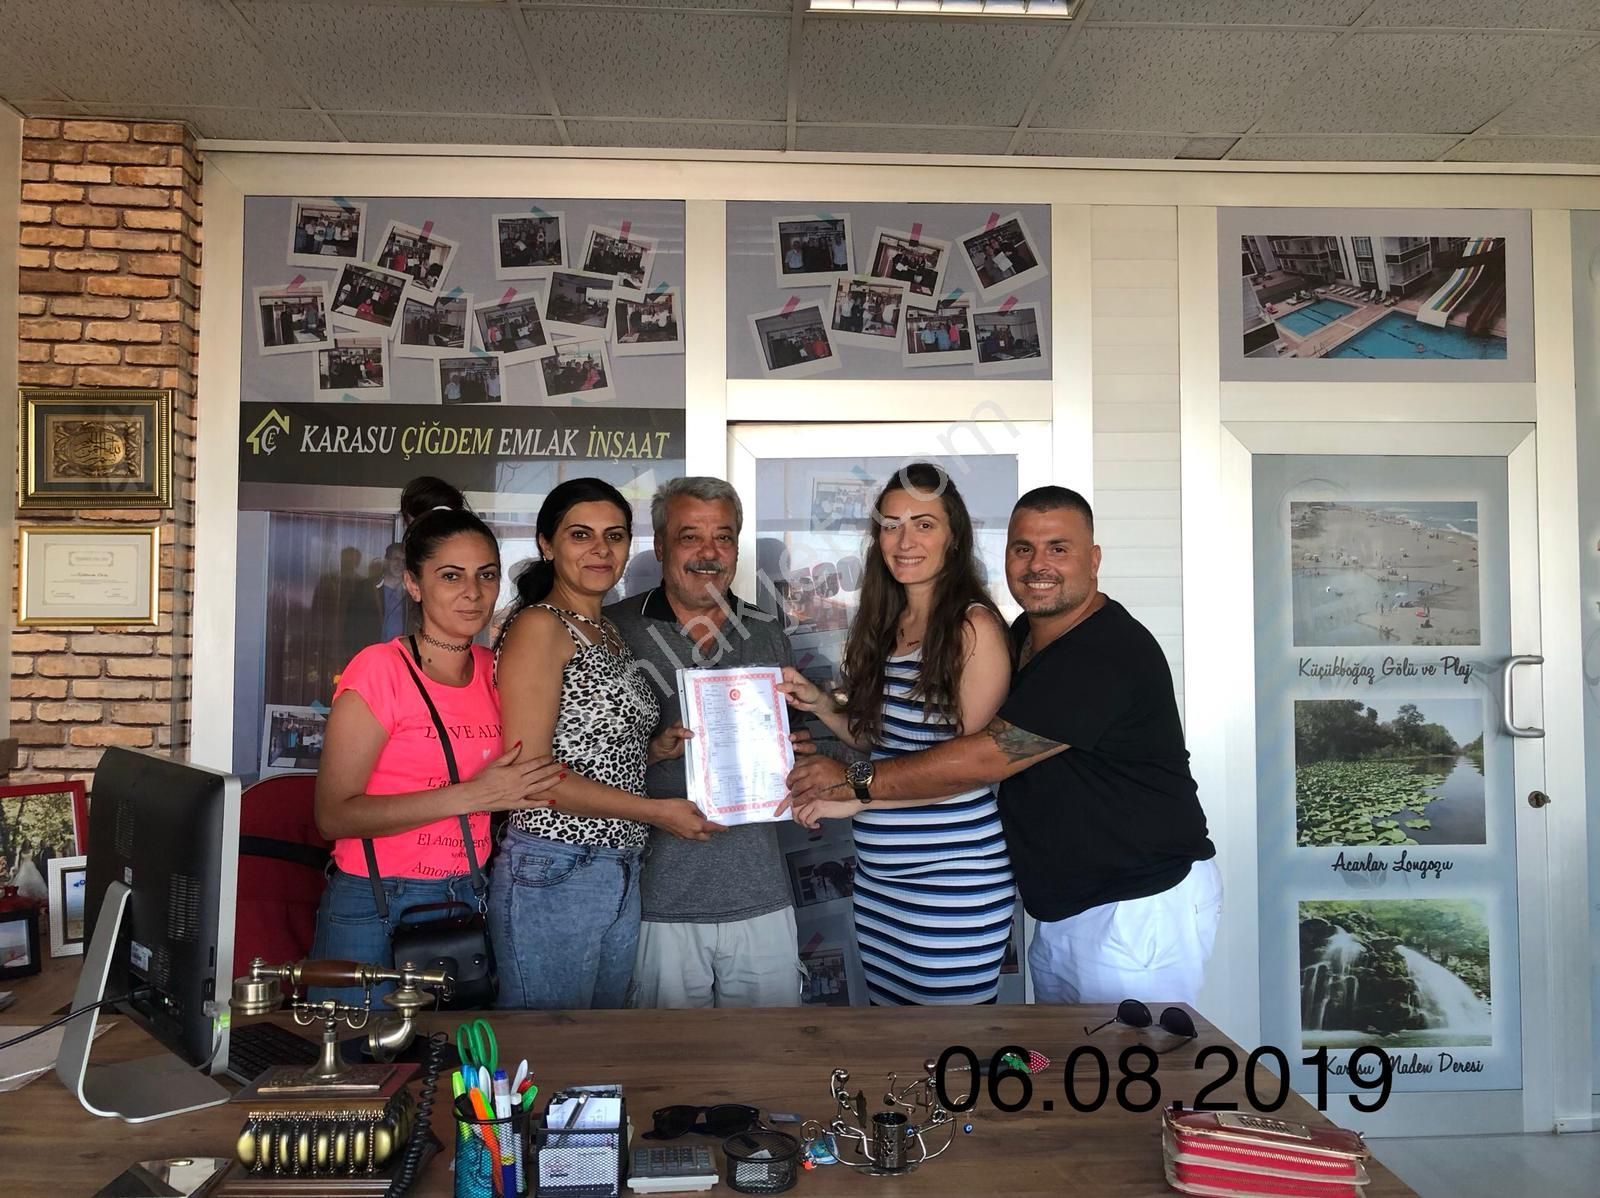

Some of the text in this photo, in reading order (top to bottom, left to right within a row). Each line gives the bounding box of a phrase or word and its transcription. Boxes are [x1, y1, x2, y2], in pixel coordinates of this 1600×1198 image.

[300, 420, 670, 465] KARASU ÇİĞDEM EMLAK İNŞAAT
[1299, 655, 1474, 686] Küçükboğaz Gölü ve Plaj
[424, 725, 474, 739] LVE
[1331, 849, 1454, 880] Acarlar Longozu
[1438, 1051, 1485, 1074] Deresi
